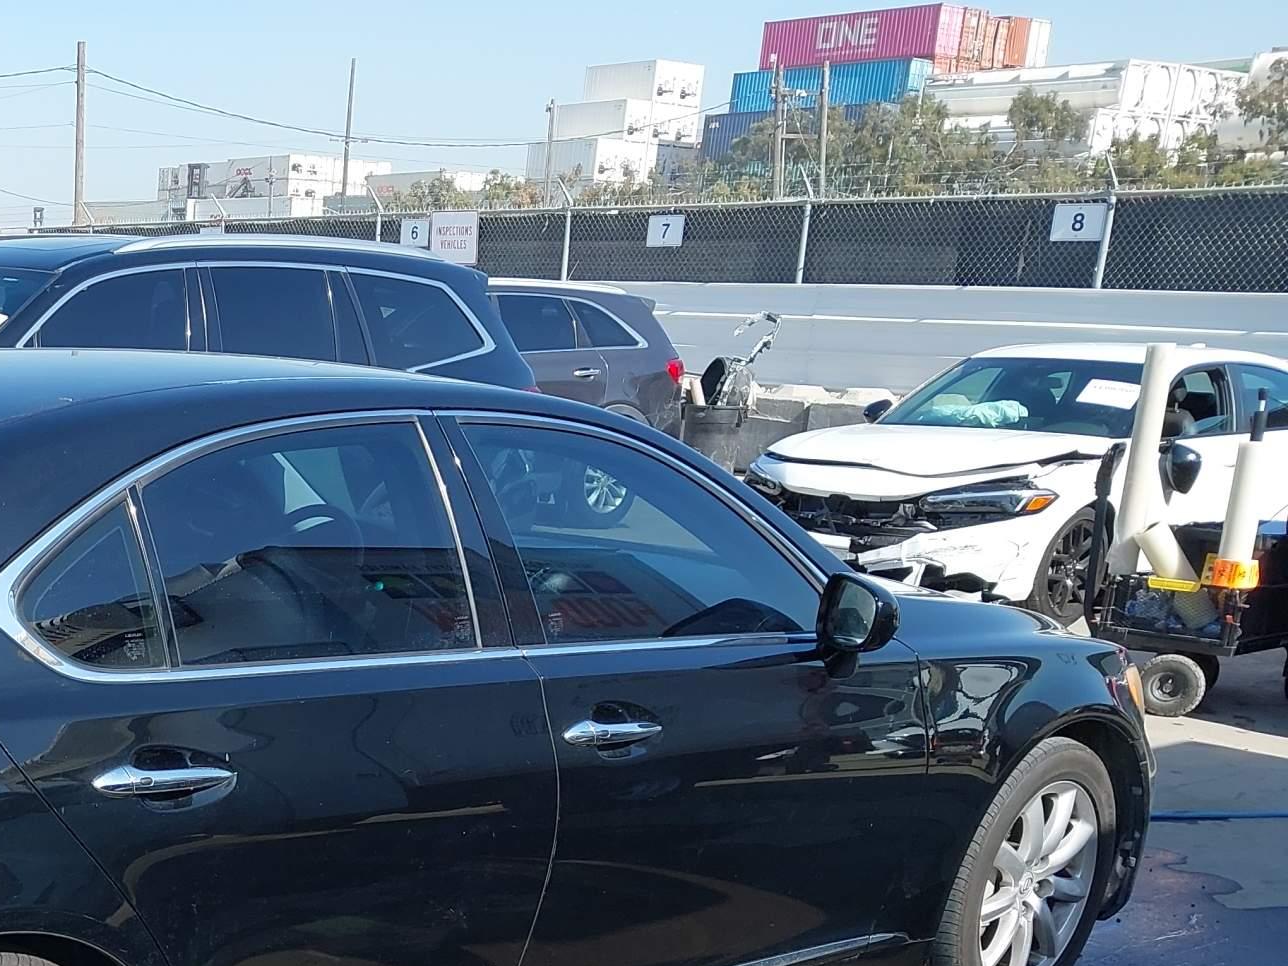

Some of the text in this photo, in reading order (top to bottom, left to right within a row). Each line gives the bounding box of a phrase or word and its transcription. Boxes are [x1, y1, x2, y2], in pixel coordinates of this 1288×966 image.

[815, 16, 878, 49] ONE
[1071, 212, 1085, 232] 8
[410, 225, 419, 240] 6
[435, 225, 473, 237] INSPECTIONS
[661, 223, 671, 239] 7
[440, 239, 467, 250] VEHICLES
